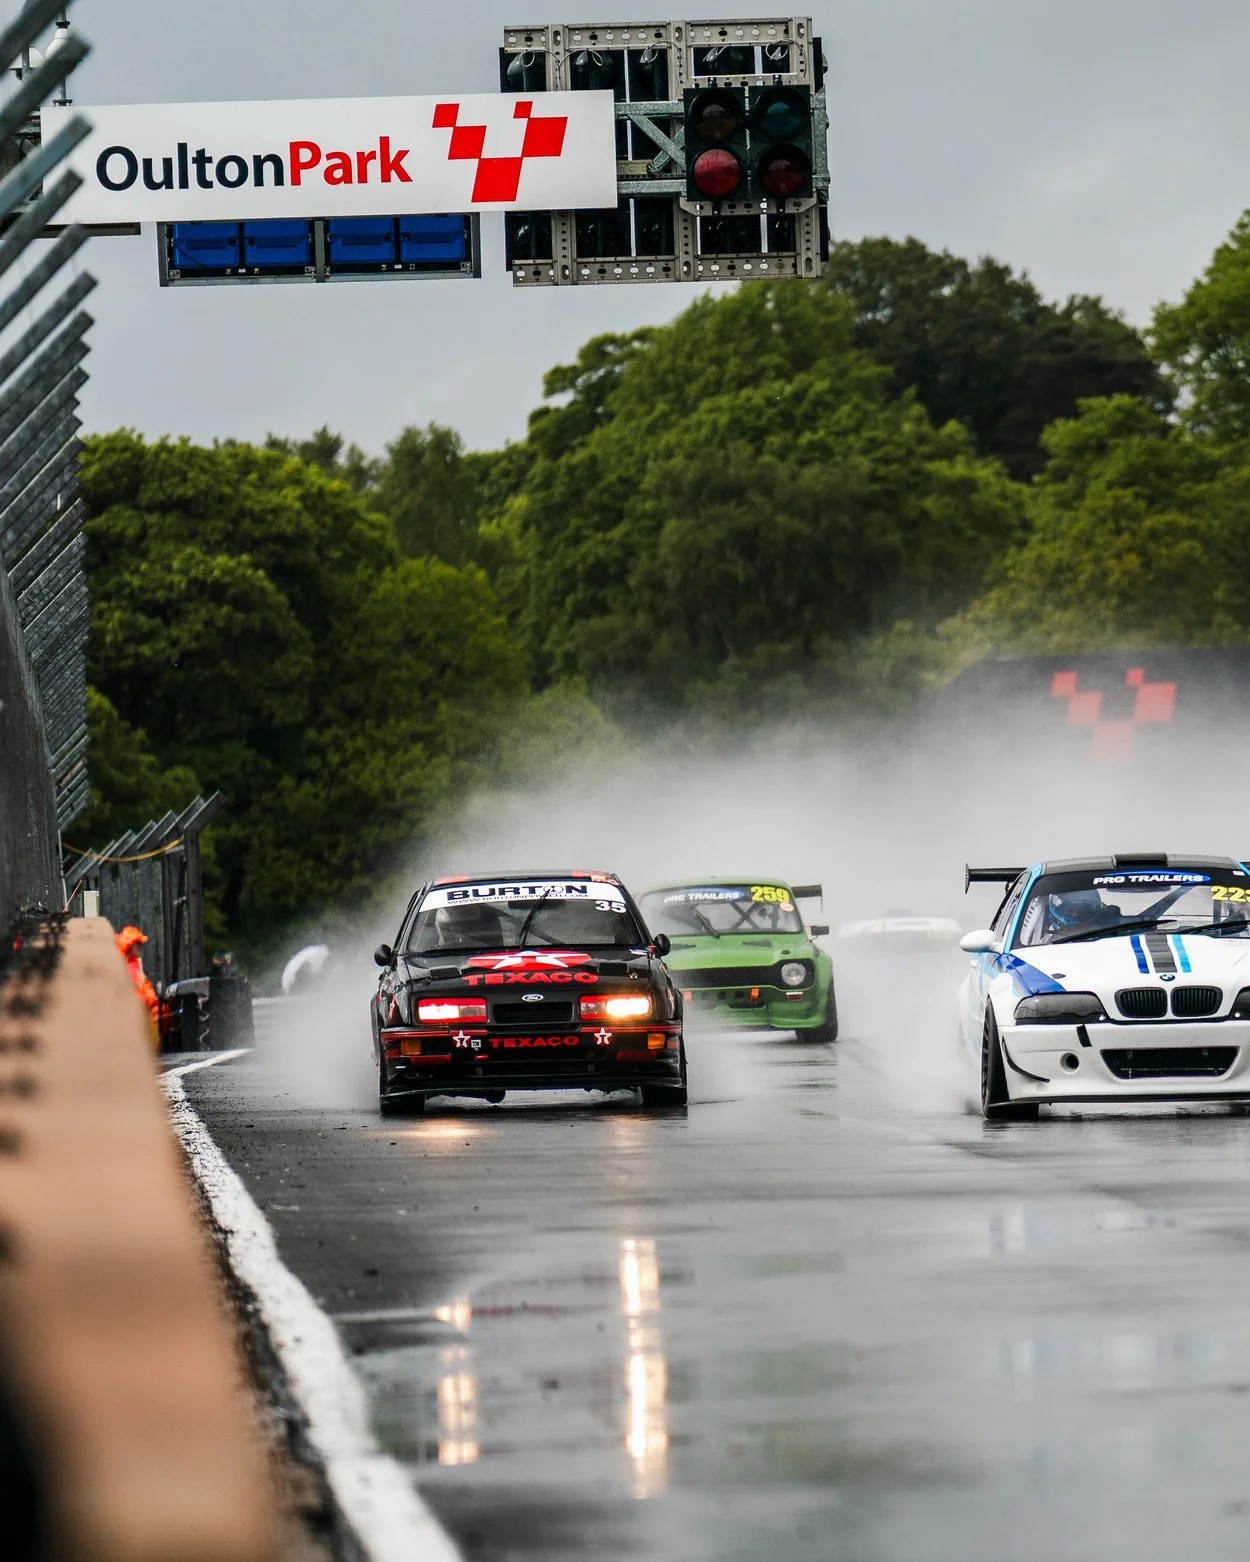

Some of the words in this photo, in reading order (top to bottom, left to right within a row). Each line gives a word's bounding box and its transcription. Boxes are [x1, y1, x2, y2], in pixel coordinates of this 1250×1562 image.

[1093, 876, 1125, 885] PRG
[1128, 874, 1204, 883] TRAILERS
[687, 891, 740, 901] TRAILERS
[750, 886, 790, 903] 259
[595, 900, 627, 914] 35
[462, 972, 599, 987] TEXACO
[489, 1036, 580, 1048] TEXACO
